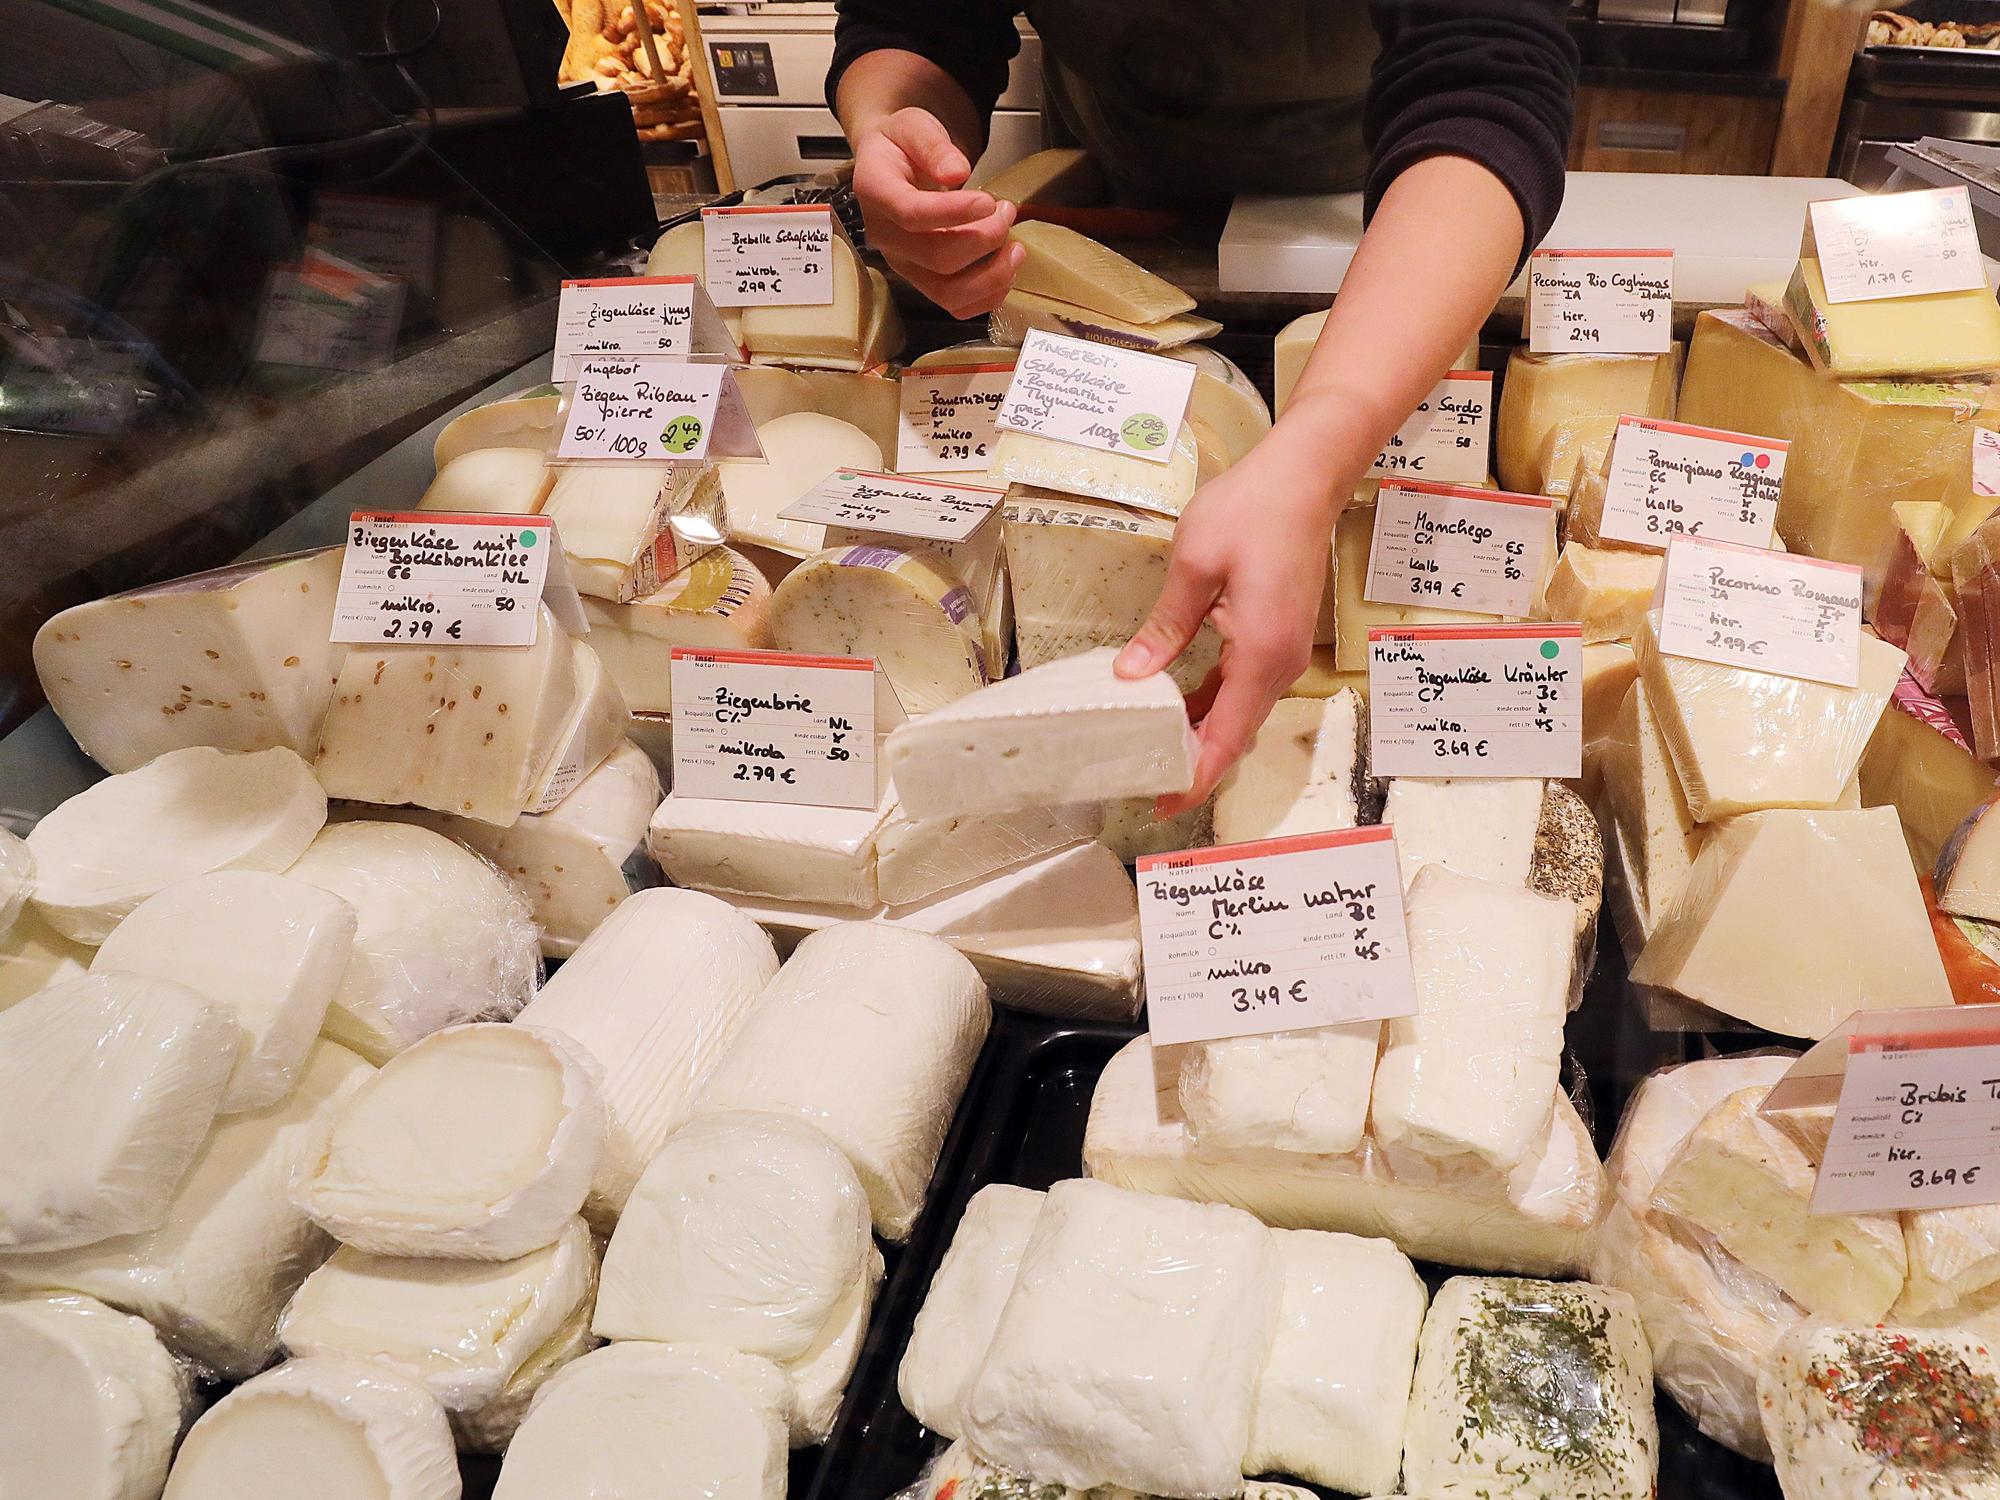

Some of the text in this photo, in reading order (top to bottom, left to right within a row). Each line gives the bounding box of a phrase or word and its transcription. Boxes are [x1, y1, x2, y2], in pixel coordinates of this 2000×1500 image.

[1943, 250, 1956, 259] 50
[1533, 273, 1581, 288] Pecorino
[1587, 273, 1607, 287] Rio
[1868, 270, 1912, 285] 1.79 €
[738, 280, 782, 292] 2.99 €
[1640, 309, 1654, 322] 49
[658, 338, 672, 348] 50
[1570, 328, 1599, 342] 2.49
[584, 363, 640, 375] Angebot
[1438, 396, 1482, 413] Sardo
[608, 434, 648, 458] 100g
[684, 438, 698, 450] €
[939, 443, 986, 459] 2.79 €
[1374, 453, 1427, 469] 2.79 €
[836, 511, 876, 521] 2.49
[1739, 510, 1756, 524] 32
[1414, 511, 1492, 543] Manchego
[1647, 515, 1703, 535] 3.29 €
[473, 534, 517, 551] mit
[390, 550, 529, 567] Bockshornklee
[502, 572, 529, 584] NL
[1504, 568, 1520, 580] 50
[1709, 567, 1782, 595] Pecorino
[1411, 578, 1465, 597] 3.99 €
[496, 597, 515, 611] 50
[383, 619, 462, 639] 2.79 €
[1706, 631, 1768, 655] 2.99 €
[1374, 647, 1424, 662] Merlin
[715, 687, 813, 717] Ziegenbrie
[829, 717, 853, 730] NL
[1534, 718, 1553, 732] 45
[826, 748, 850, 761] 50
[1434, 740, 1488, 756] 3.69 €
[733, 764, 796, 784] 2.79 €
[1213, 882, 1376, 919] Merlin natur
[1168, 950, 1199, 960] Rohmilch
[1355, 942, 1381, 960] 45
[1207, 960, 1271, 981] mikro
[1231, 980, 1308, 1012] 3.49 €
[1909, 1167, 1980, 1188] 3.69 €
